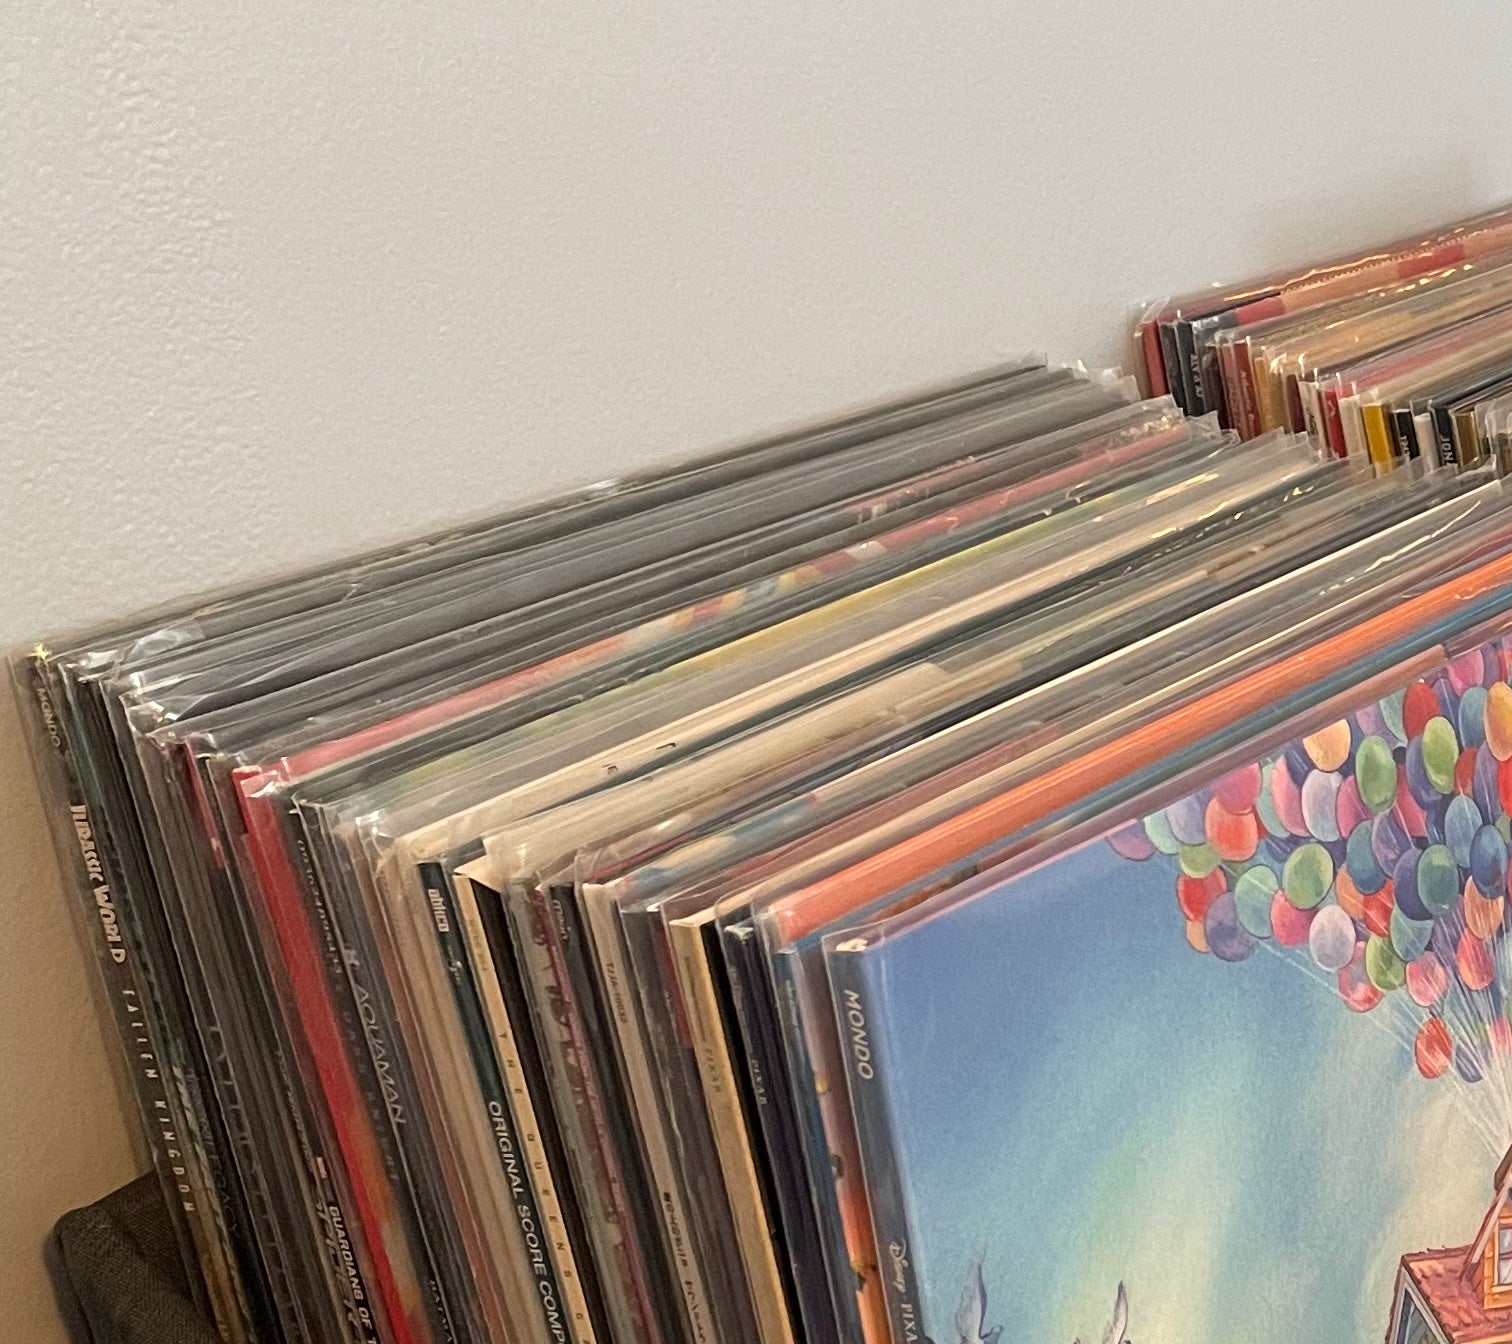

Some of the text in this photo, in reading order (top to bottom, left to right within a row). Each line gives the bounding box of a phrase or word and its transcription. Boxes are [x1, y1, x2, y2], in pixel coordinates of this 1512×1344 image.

[35, 686, 62, 748] MONDO
[67, 801, 109, 885] JURASSIC
[90, 883, 131, 964] WORLD
[120, 988, 160, 1080] FALLEN
[151, 1098, 198, 1213] KINGDOM
[353, 981, 407, 1126] AQUAMAN
[841, 987, 875, 1081] MONDO
[486, 1099, 525, 1199] ORIGINAL
[516, 1203, 547, 1276] SCORE
[327, 1204, 364, 1301] GUARDIANS
[357, 1305, 372, 1331] OF
